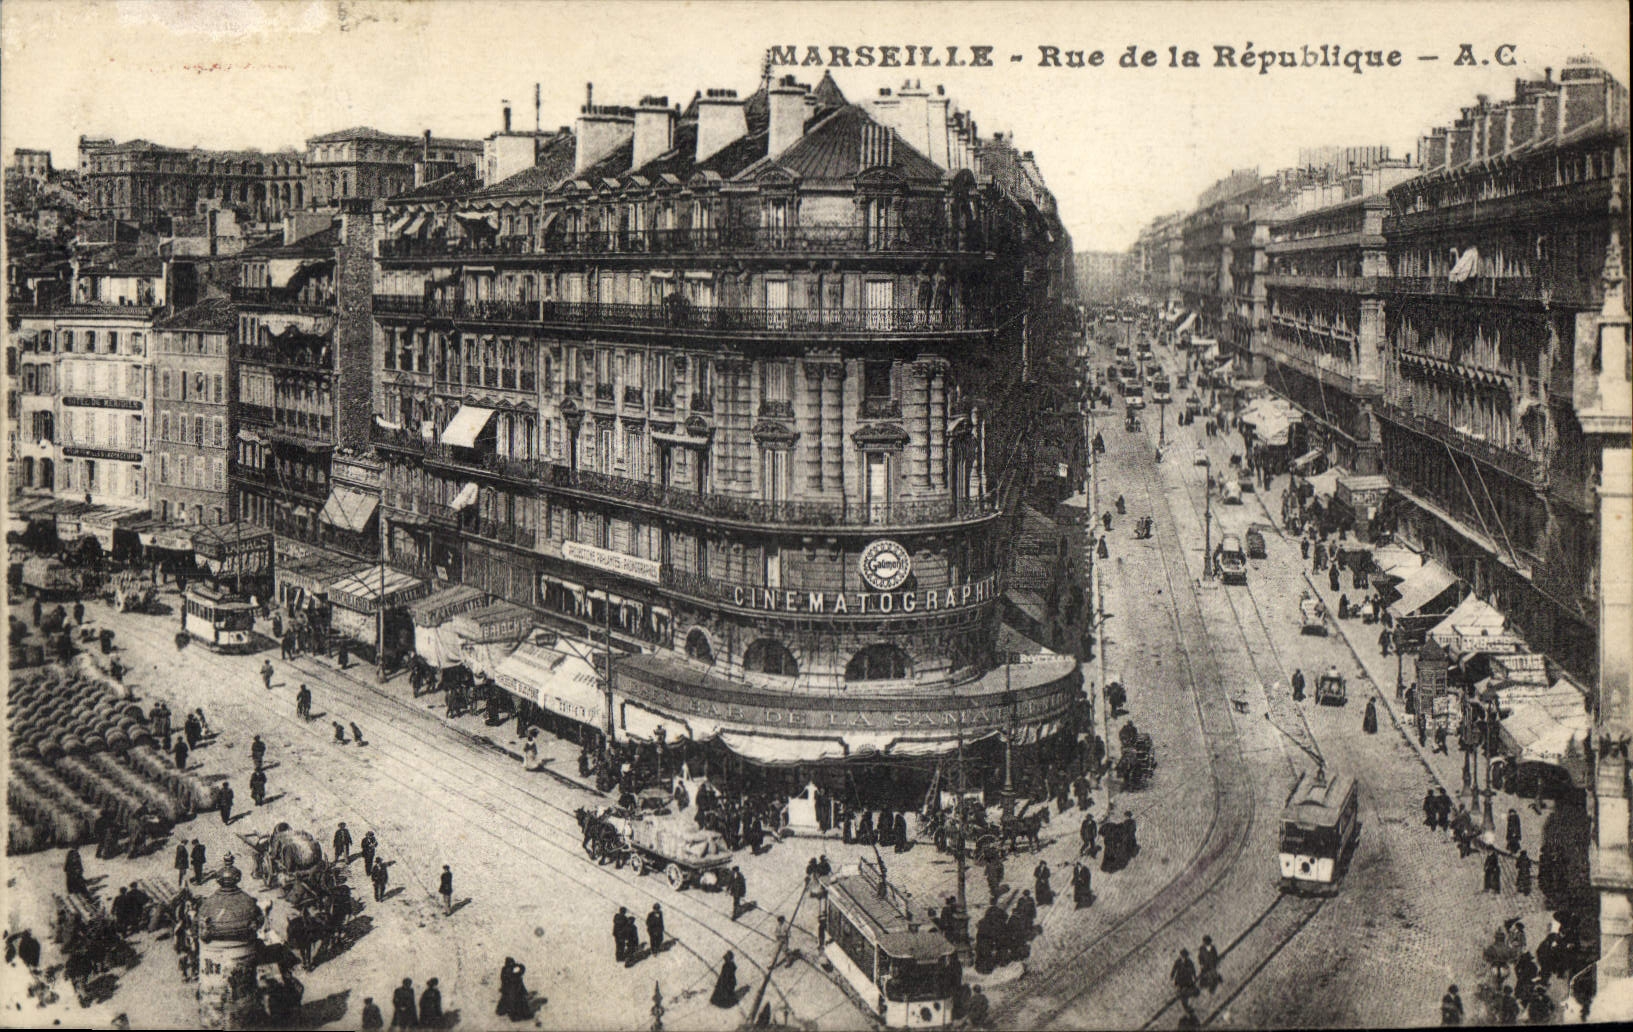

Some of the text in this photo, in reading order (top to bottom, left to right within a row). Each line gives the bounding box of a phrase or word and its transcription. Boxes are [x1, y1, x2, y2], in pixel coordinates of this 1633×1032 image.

[868, 558, 904, 573] Gaumont
[688, 699, 744, 718] BAR
[764, 710, 807, 725] DE
[828, 710, 873, 726] LA
